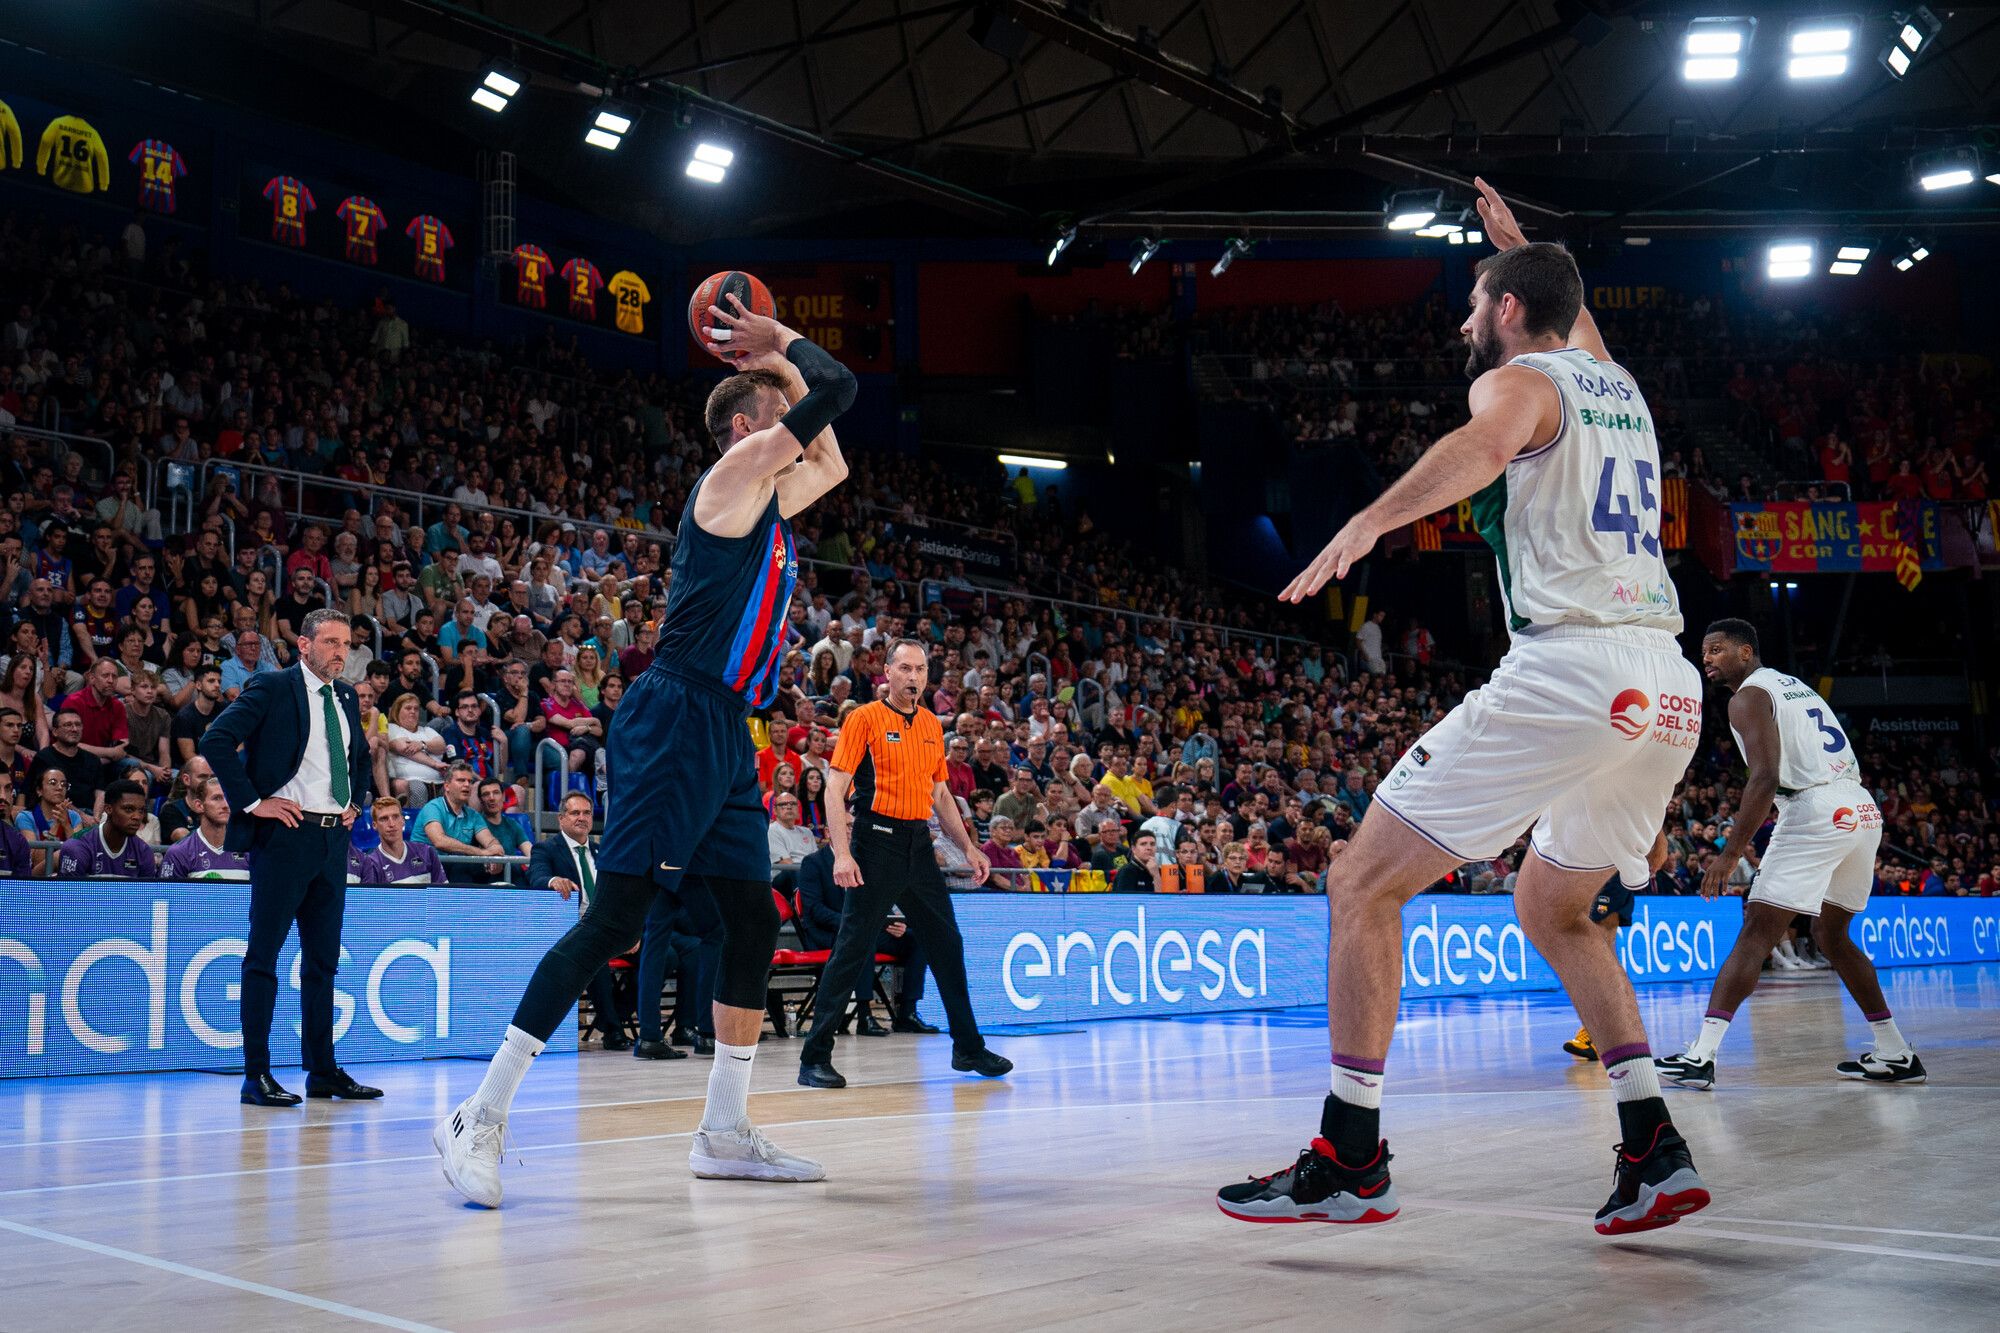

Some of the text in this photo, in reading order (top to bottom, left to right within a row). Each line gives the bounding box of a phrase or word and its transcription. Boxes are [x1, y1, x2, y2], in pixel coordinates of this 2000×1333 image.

[61, 136, 89, 162] 16
[143, 156, 173, 185] 14
[282, 194, 298, 218] 8
[354, 213, 370, 237] 7
[423, 231, 438, 255] 5
[525, 260, 540, 281] 4
[576, 275, 589, 295] 2
[619, 287, 640, 307] 28
[793, 293, 845, 326] QUE
[1591, 456, 1658, 559] 45
[1784, 507, 1851, 541] SANG
[1656, 713, 1702, 735] DEL SO
[1806, 707, 1846, 753] 3
[1859, 813, 1873, 823] DEL
[1861, 903, 1951, 961] endesa
[1002, 904, 1267, 1011] endesa
